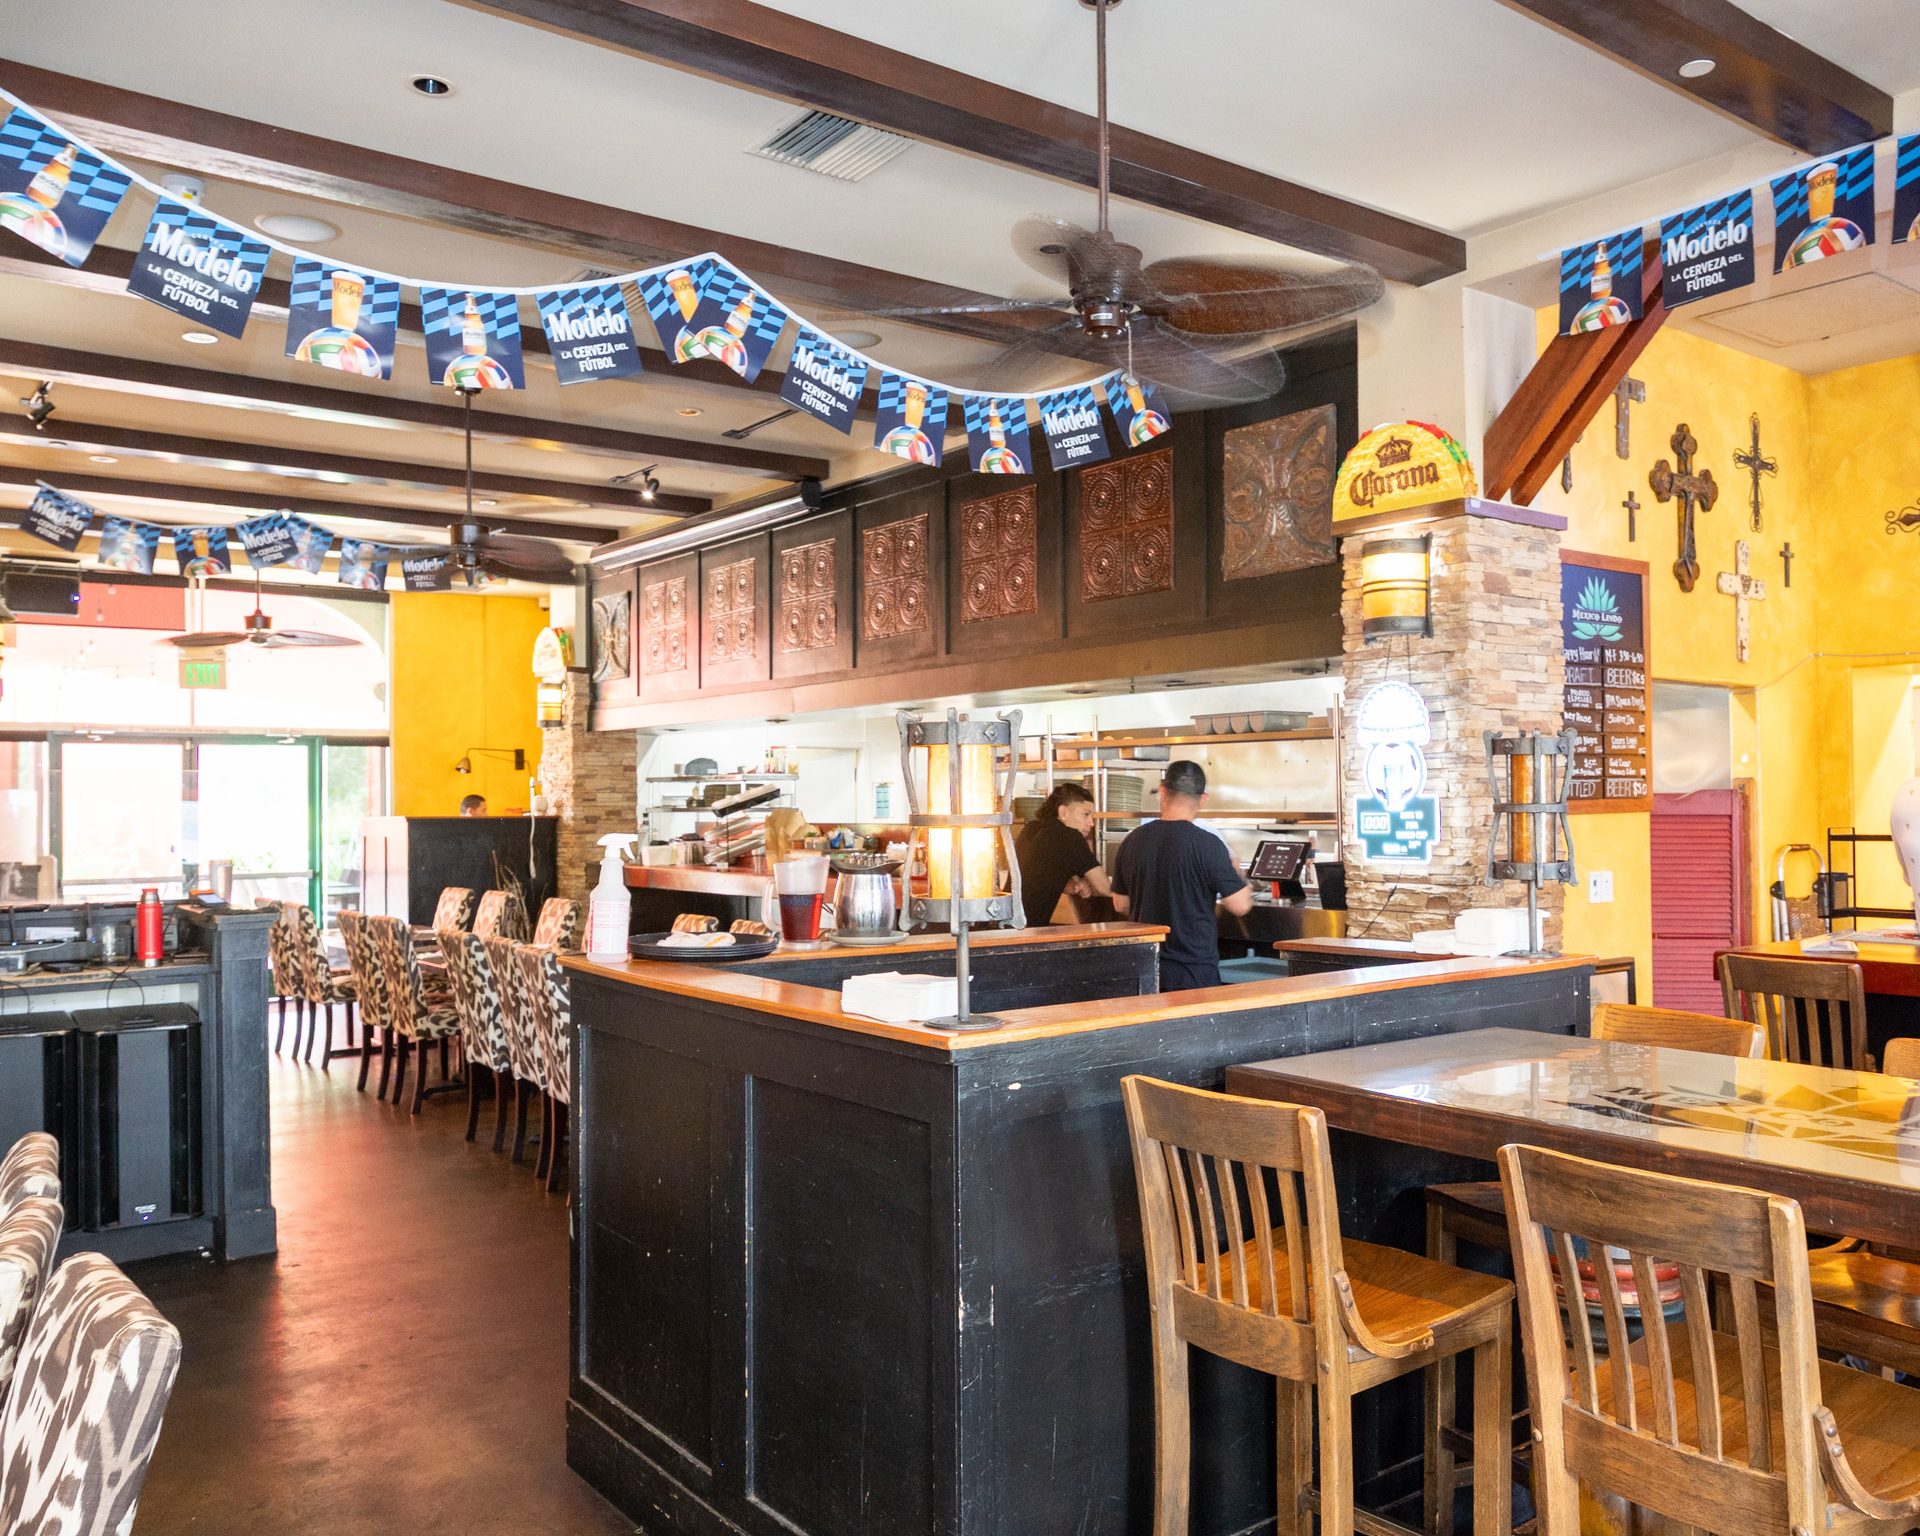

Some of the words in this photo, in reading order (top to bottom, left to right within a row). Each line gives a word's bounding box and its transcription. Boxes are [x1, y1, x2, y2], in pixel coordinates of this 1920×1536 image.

[149, 221, 253, 292] Modelo
[1666, 219, 1748, 267] Modelo
[1671, 273, 1682, 282] LA
[1682, 255, 1728, 280] CERVEZA
[1728, 253, 1744, 264] DEL
[1686, 271, 1726, 293] FÚTBOL
[147, 263, 161, 276] LA
[163, 268, 220, 303] CERVEZA
[220, 295, 239, 309] DEL
[161, 283, 211, 315] FÚTBOL
[547, 307, 628, 343] Modelo
[560, 350, 573, 360] LA
[572, 342, 616, 359] CERVEZA
[614, 343, 630, 351] DEL
[578, 356, 617, 373] FÚTBOL
[794, 344, 857, 400] Modelo
[792, 376, 802, 387] LA
[802, 380, 836, 407] CERVEZA
[800, 392, 832, 417] FÚTBOL
[1044, 406, 1099, 437] Modelo
[1061, 433, 1092, 449] CERVEZA
[1066, 445, 1093, 459] FÚTBOL
[1349, 462, 1440, 509] Corona
[32, 497, 85, 532] Modelo
[242, 526, 290, 551] Modelo
[403, 557, 444, 573] Modelo
[1607, 667, 1632, 685] BEER
[1606, 779, 1632, 798] BEER
